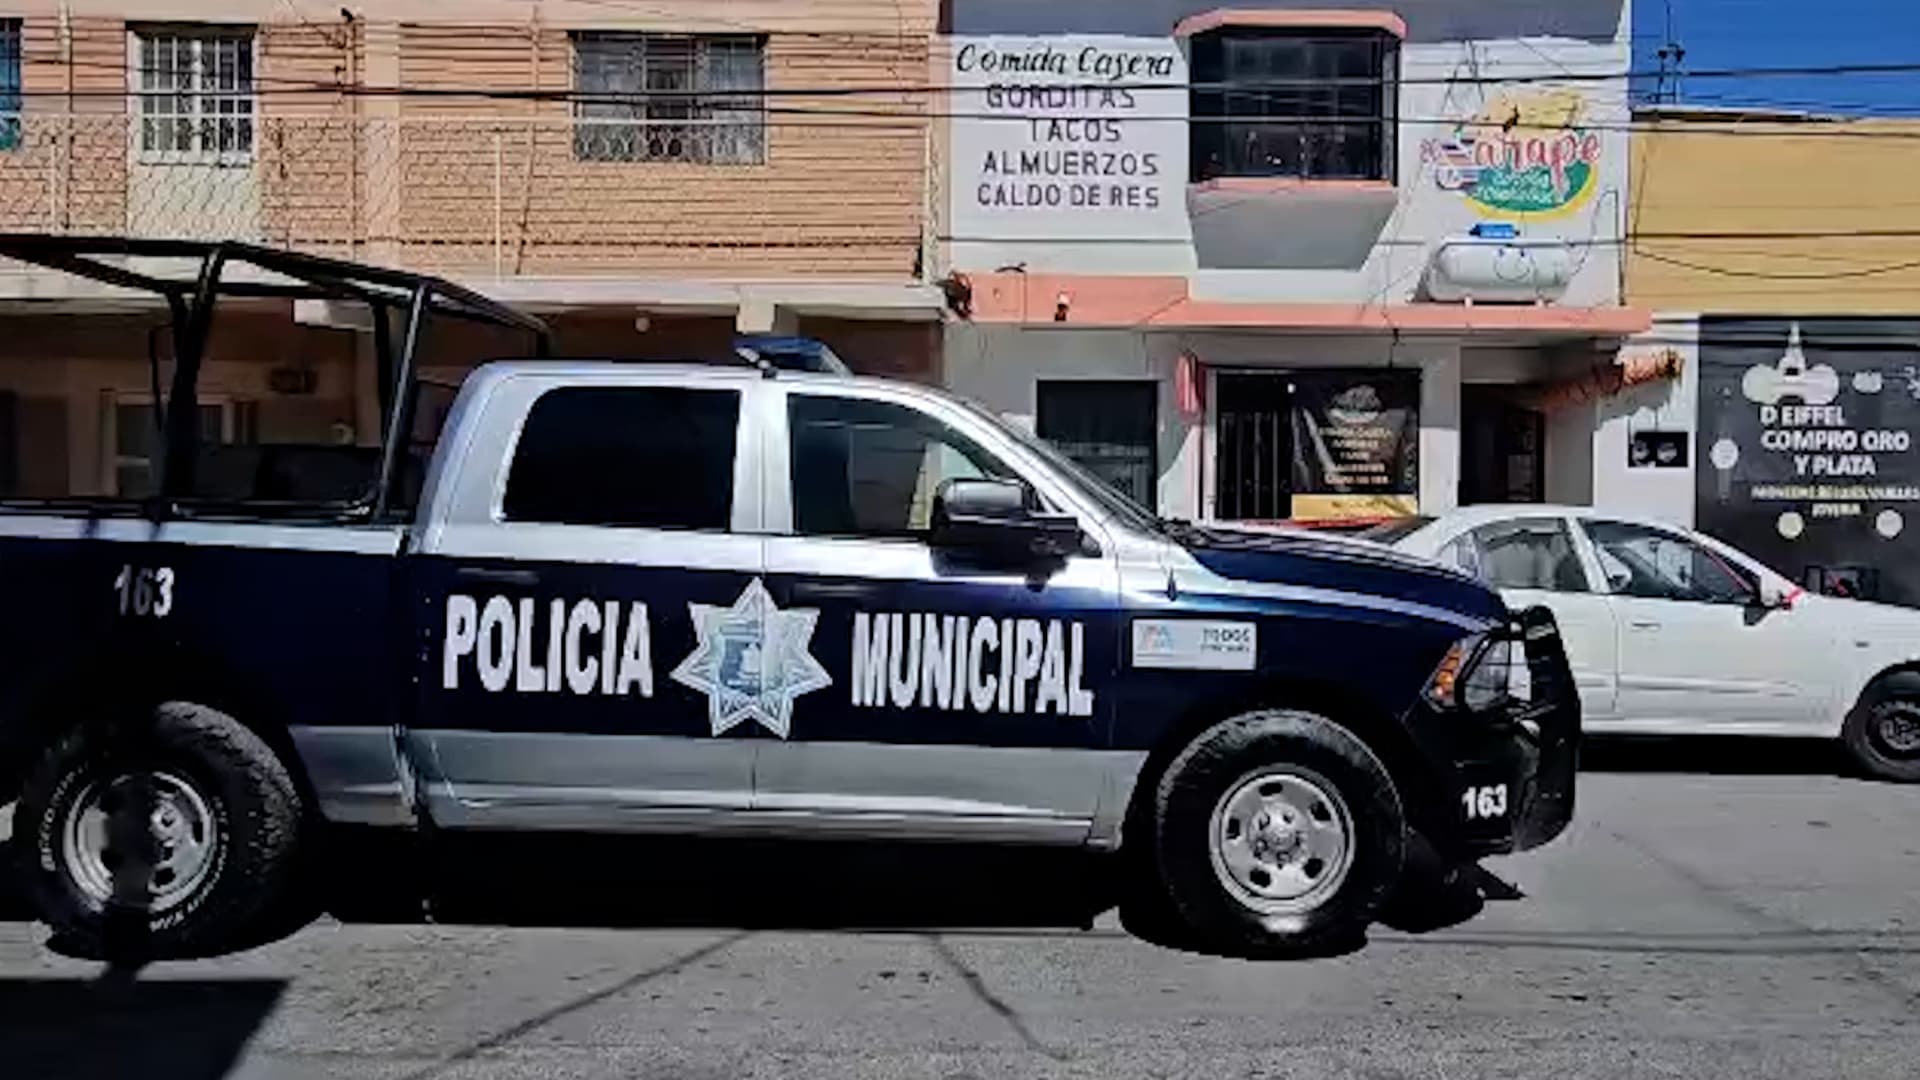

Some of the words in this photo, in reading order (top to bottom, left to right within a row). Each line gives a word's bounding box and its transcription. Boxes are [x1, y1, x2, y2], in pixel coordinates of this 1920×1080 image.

[957, 44, 1067, 75] Comida
[986, 84, 1137, 109] GORDITAS
[1029, 118, 1121, 143] TACOS
[984, 151, 1160, 177] ALMUERZOS
[977, 183, 1062, 207] CALDO
[1070, 184, 1102, 208] DE
[1110, 186, 1161, 209] RES
[1781, 405, 1846, 427] EIFFEL
[1760, 429, 1857, 451] COMPRO
[1861, 430, 1911, 451] ORO
[1793, 454, 1811, 475] Y
[1812, 454, 1877, 476] PLATA
[114, 564, 175, 618] 163
[442, 595, 654, 698] POLICIA
[850, 611, 1094, 718] MUNICIPAL
[1461, 783, 1508, 820] 163
